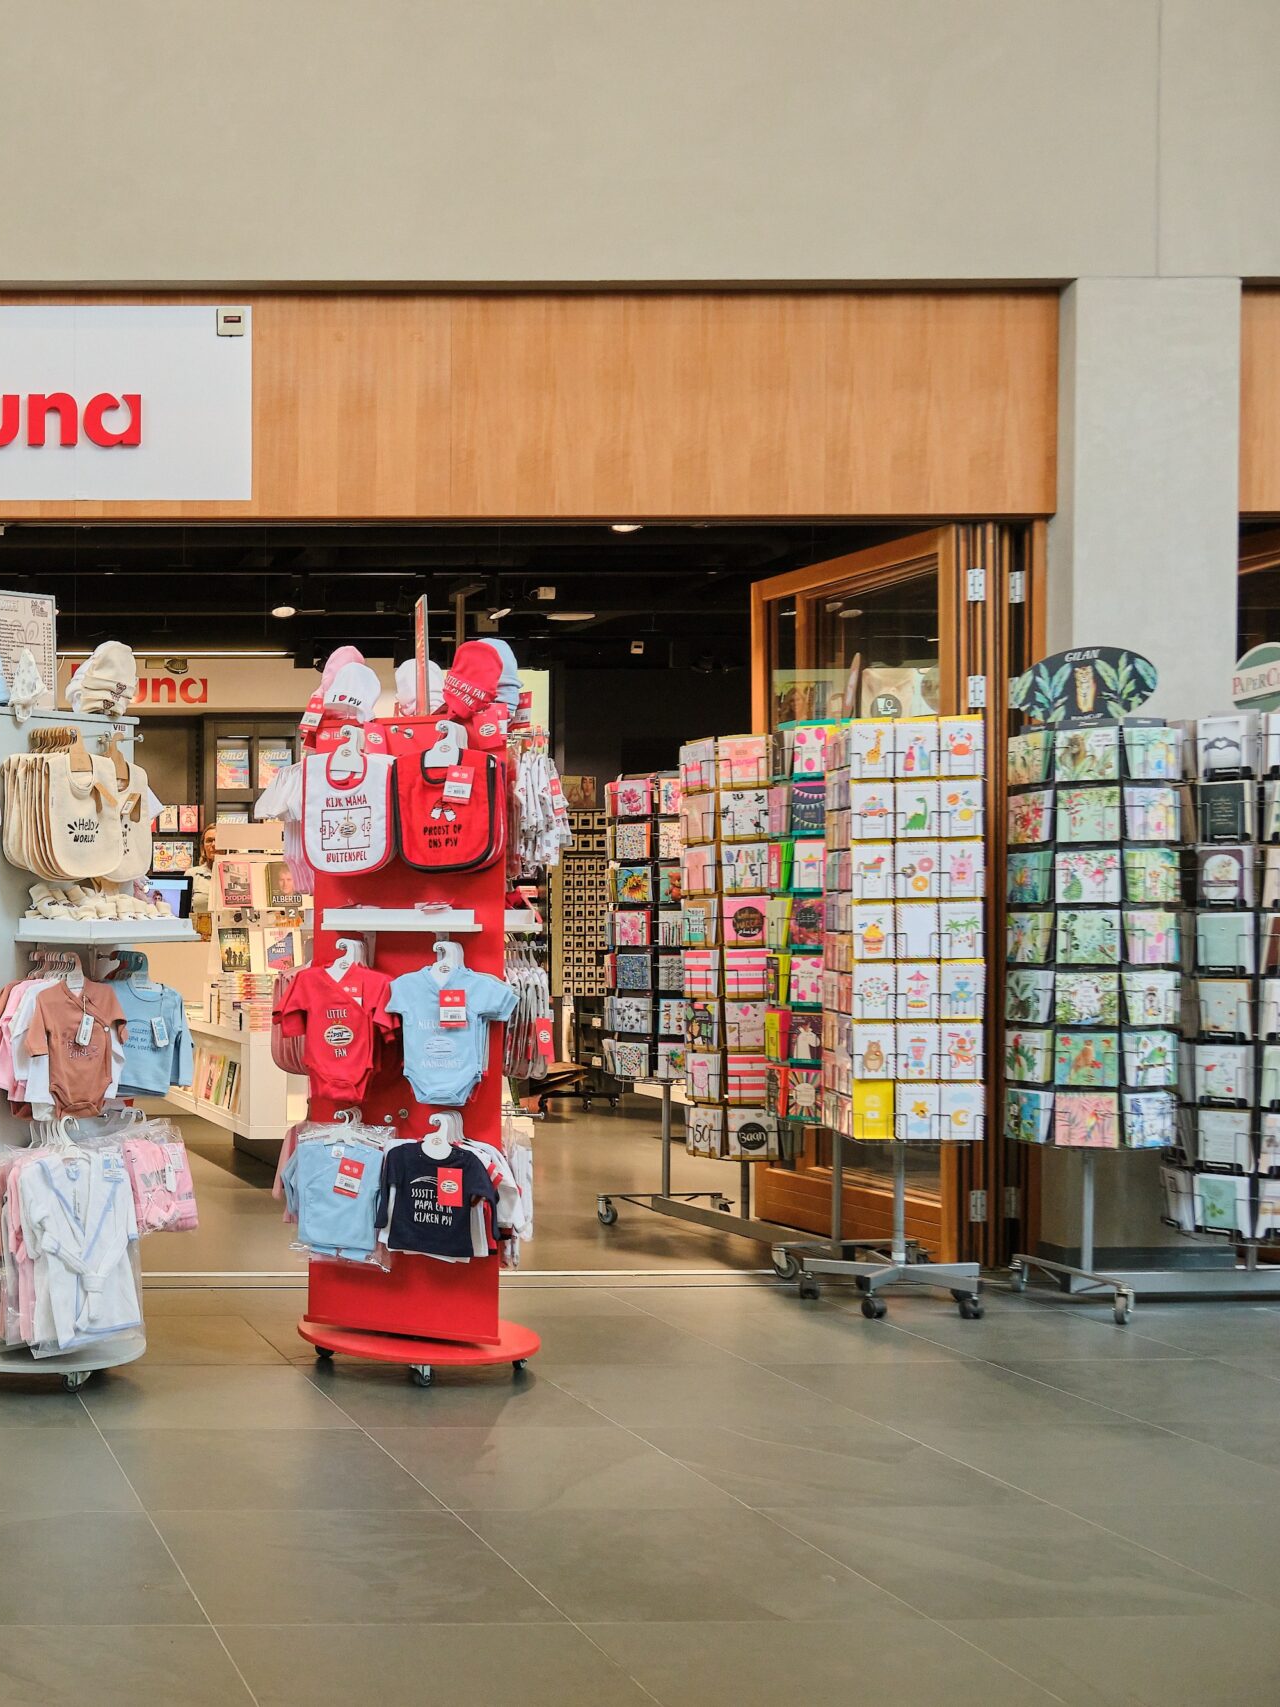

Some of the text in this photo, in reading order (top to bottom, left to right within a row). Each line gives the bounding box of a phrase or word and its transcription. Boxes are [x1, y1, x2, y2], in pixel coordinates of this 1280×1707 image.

[1065, 649, 1100, 662] GILAN
[136, 677, 208, 704] una
[472, 688, 487, 700] FAN
[348, 697, 362, 706] PSV
[423, 824, 462, 836] PROOST OP
[428, 838, 458, 849] ONS PSV
[326, 851, 367, 863] BUITENSPEL
[725, 849, 765, 864] DANK
[272, 895, 302, 904] ALBERTO
[289, 909, 296, 917] 2
[326, 1009, 348, 1019] LITTLE
[335, 1048, 347, 1058] FAN
[739, 1132, 766, 1143] Baan
[414, 1200, 433, 1210] PAPA
[414, 1212, 453, 1227] KIJKEN PSV
